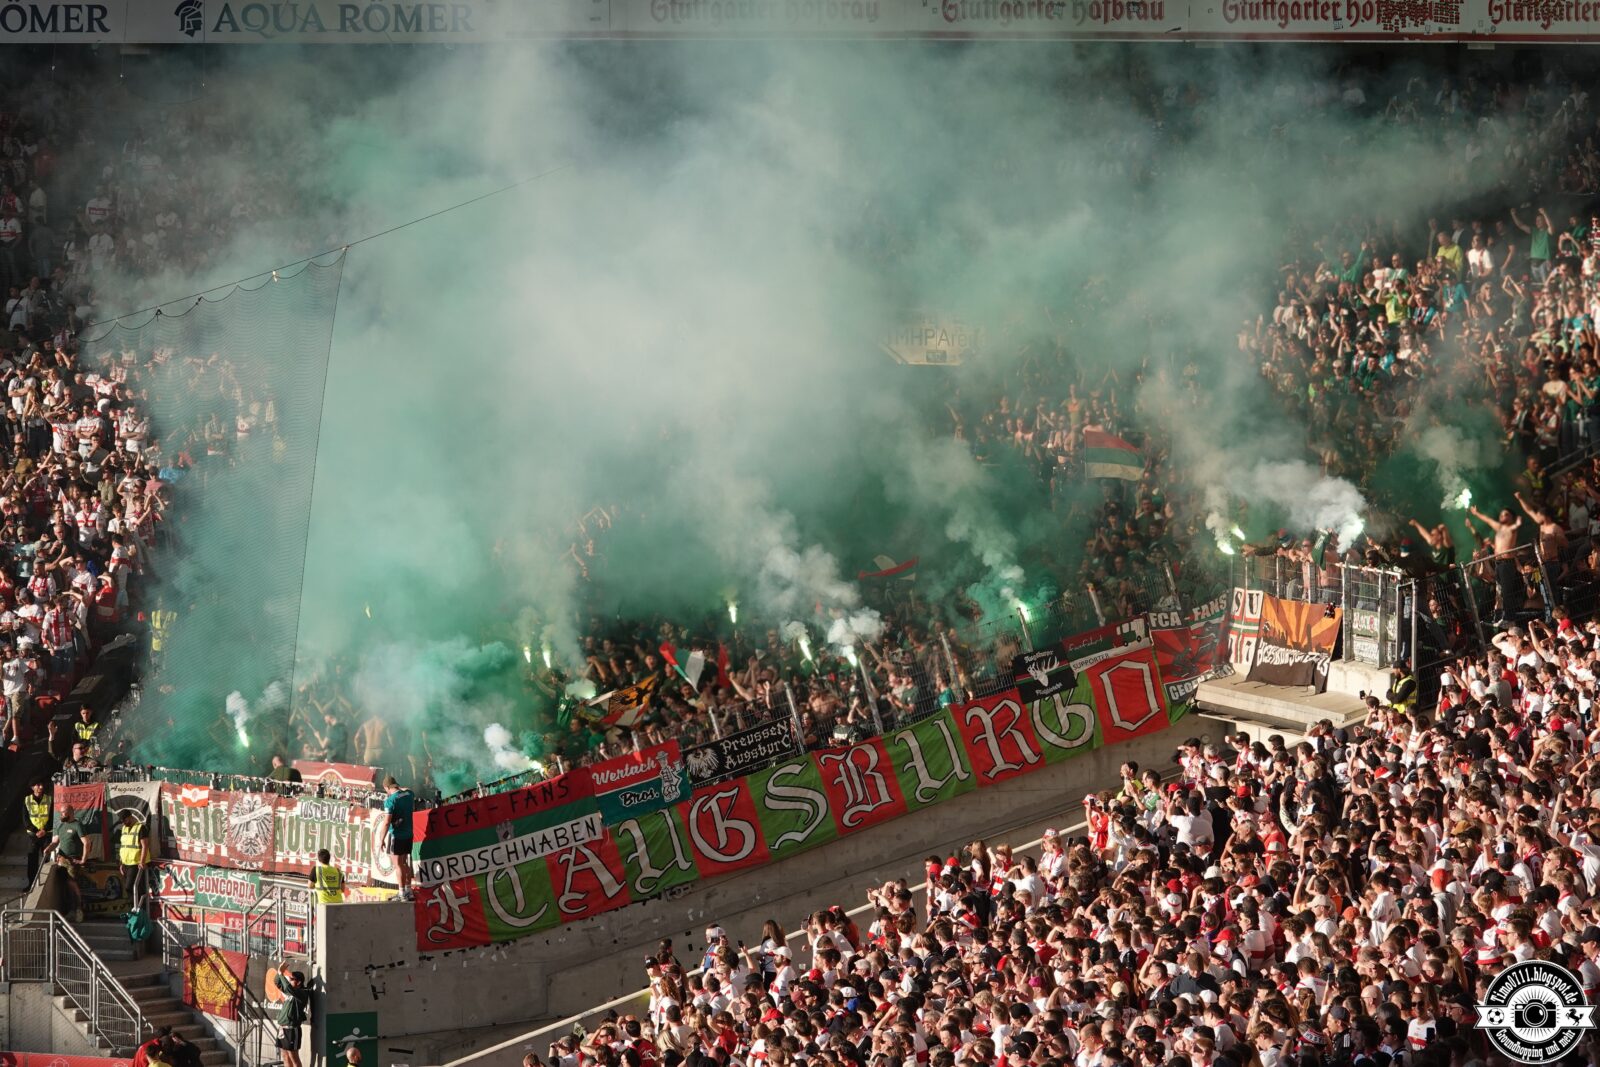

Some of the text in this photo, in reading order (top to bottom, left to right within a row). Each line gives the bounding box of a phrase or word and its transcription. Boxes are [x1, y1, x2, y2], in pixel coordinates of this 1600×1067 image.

[212, 0, 475, 38] AQUA RÖMER
[1222, 0, 1341, 29] Stuttgarter
[1149, 611, 1182, 627] FCA
[1192, 592, 1227, 621] FANS
[1073, 653, 1109, 670] SUPPORTER
[592, 757, 657, 785] Wertach
[110, 786, 145, 794] Augusta
[427, 803, 479, 833] FCA
[509, 776, 570, 813] FANS
[619, 788, 659, 807] Bros.
[162, 800, 225, 844] LEGIO
[274, 815, 371, 865] AUGUSTA
[418, 817, 597, 883] NORDSCHWABEN
[197, 875, 256, 900] CONCORDIA
